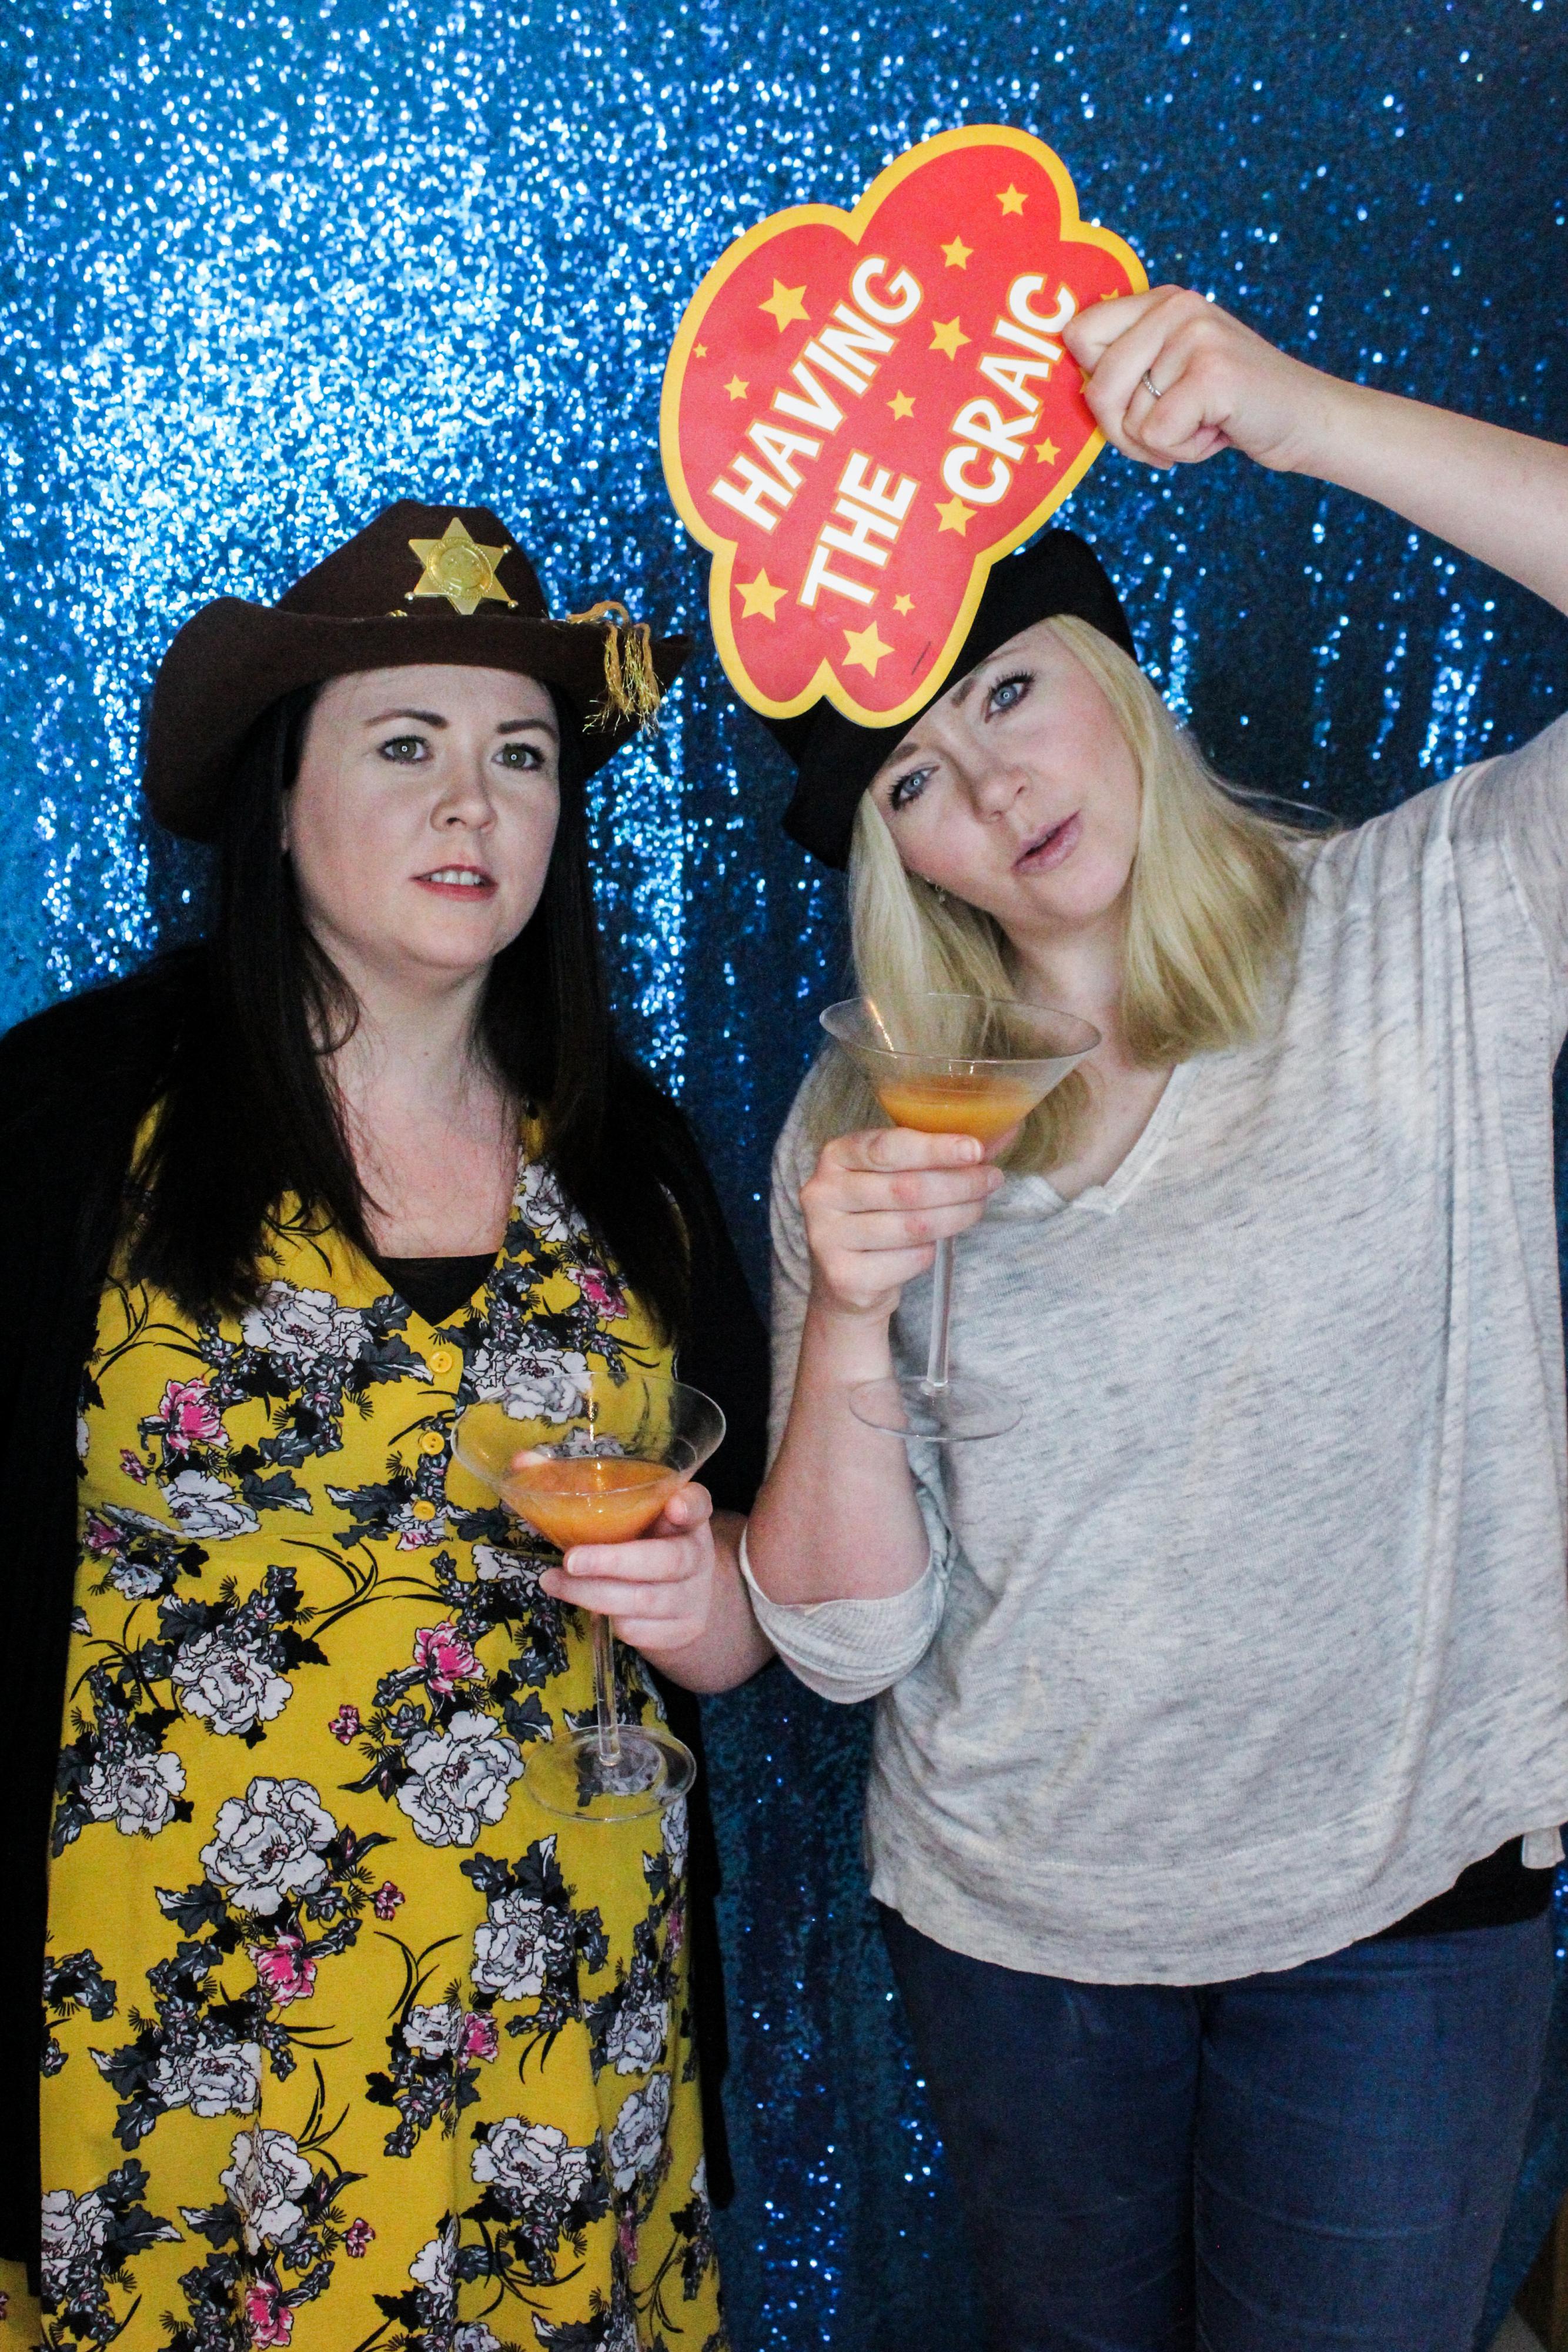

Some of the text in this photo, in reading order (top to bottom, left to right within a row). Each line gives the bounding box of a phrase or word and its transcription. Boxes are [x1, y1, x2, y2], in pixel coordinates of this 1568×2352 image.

[710, 257, 921, 532] HAVING
[942, 275, 1076, 504] CRAIC
[800, 452, 918, 606] THE
